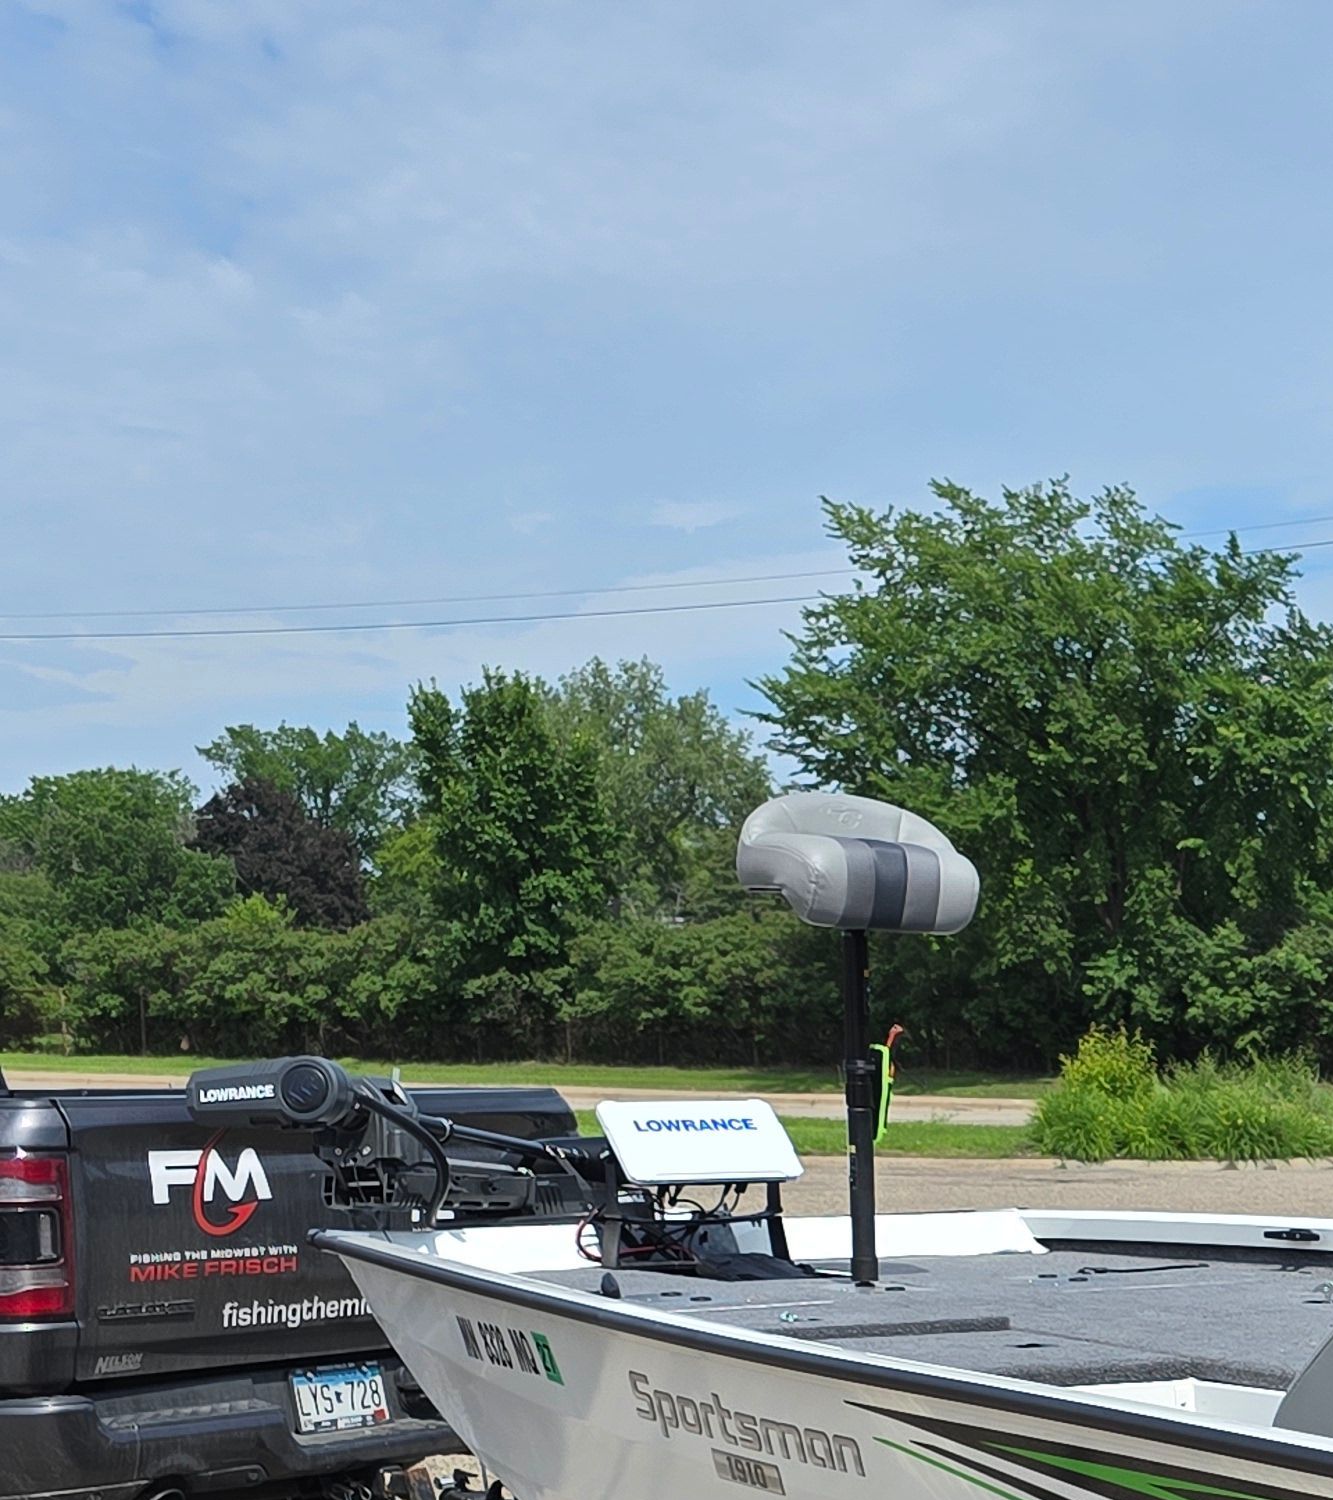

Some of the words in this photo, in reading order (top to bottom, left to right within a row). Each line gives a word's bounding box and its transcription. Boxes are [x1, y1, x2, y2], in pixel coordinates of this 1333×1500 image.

[200, 1084, 275, 1103] LOWRANCE
[633, 1118, 758, 1132] LOWRANCE
[148, 1147, 273, 1205] FM
[130, 1252, 182, 1264] FISHING
[184, 1249, 208, 1260] THE
[211, 1246, 266, 1259] MIDWEST
[268, 1244, 298, 1256] WITH
[130, 1262, 199, 1282] MIKE
[203, 1256, 297, 1277] FRISCH
[296, 1384, 335, 1417] LYS
[344, 1379, 382, 1411] 728
[628, 1370, 867, 1478] Sportsman
[726, 1455, 768, 1489] 1910
